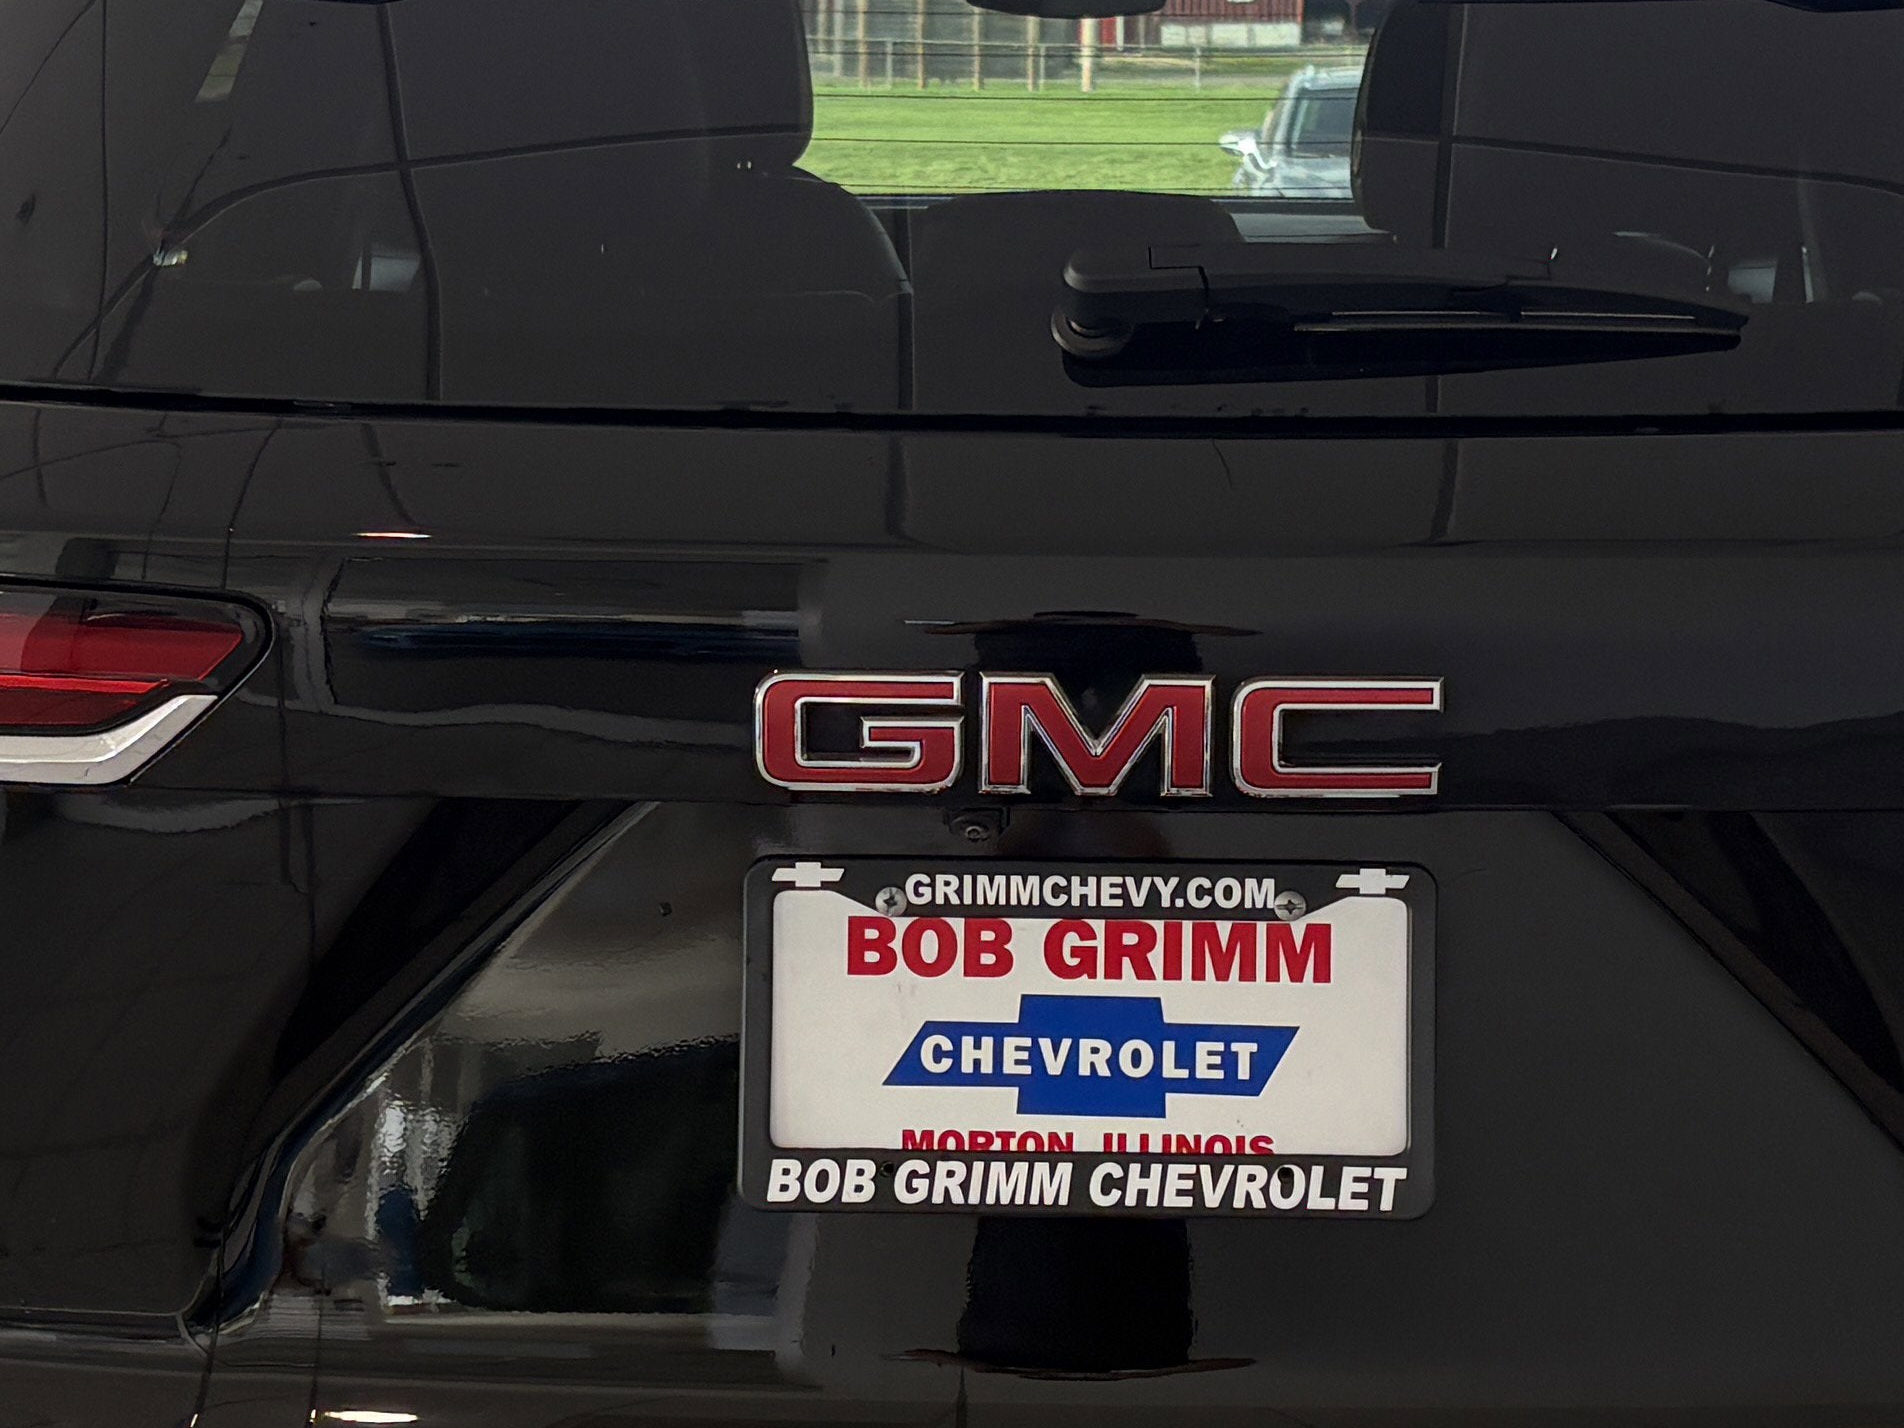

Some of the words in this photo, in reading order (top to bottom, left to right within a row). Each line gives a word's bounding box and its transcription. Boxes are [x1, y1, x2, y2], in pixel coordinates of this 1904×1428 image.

[754, 671, 1444, 798] GMC
[904, 874, 1276, 910] GRIMMCHEVY.COM
[846, 915, 1014, 979] BOB
[1043, 918, 1332, 984] GRIMM
[919, 1034, 1259, 1081] CHEVROLET
[766, 1158, 876, 1205] BOB
[893, 1160, 1074, 1207] GRIMM
[1088, 1162, 1408, 1212] CHEVROLET
